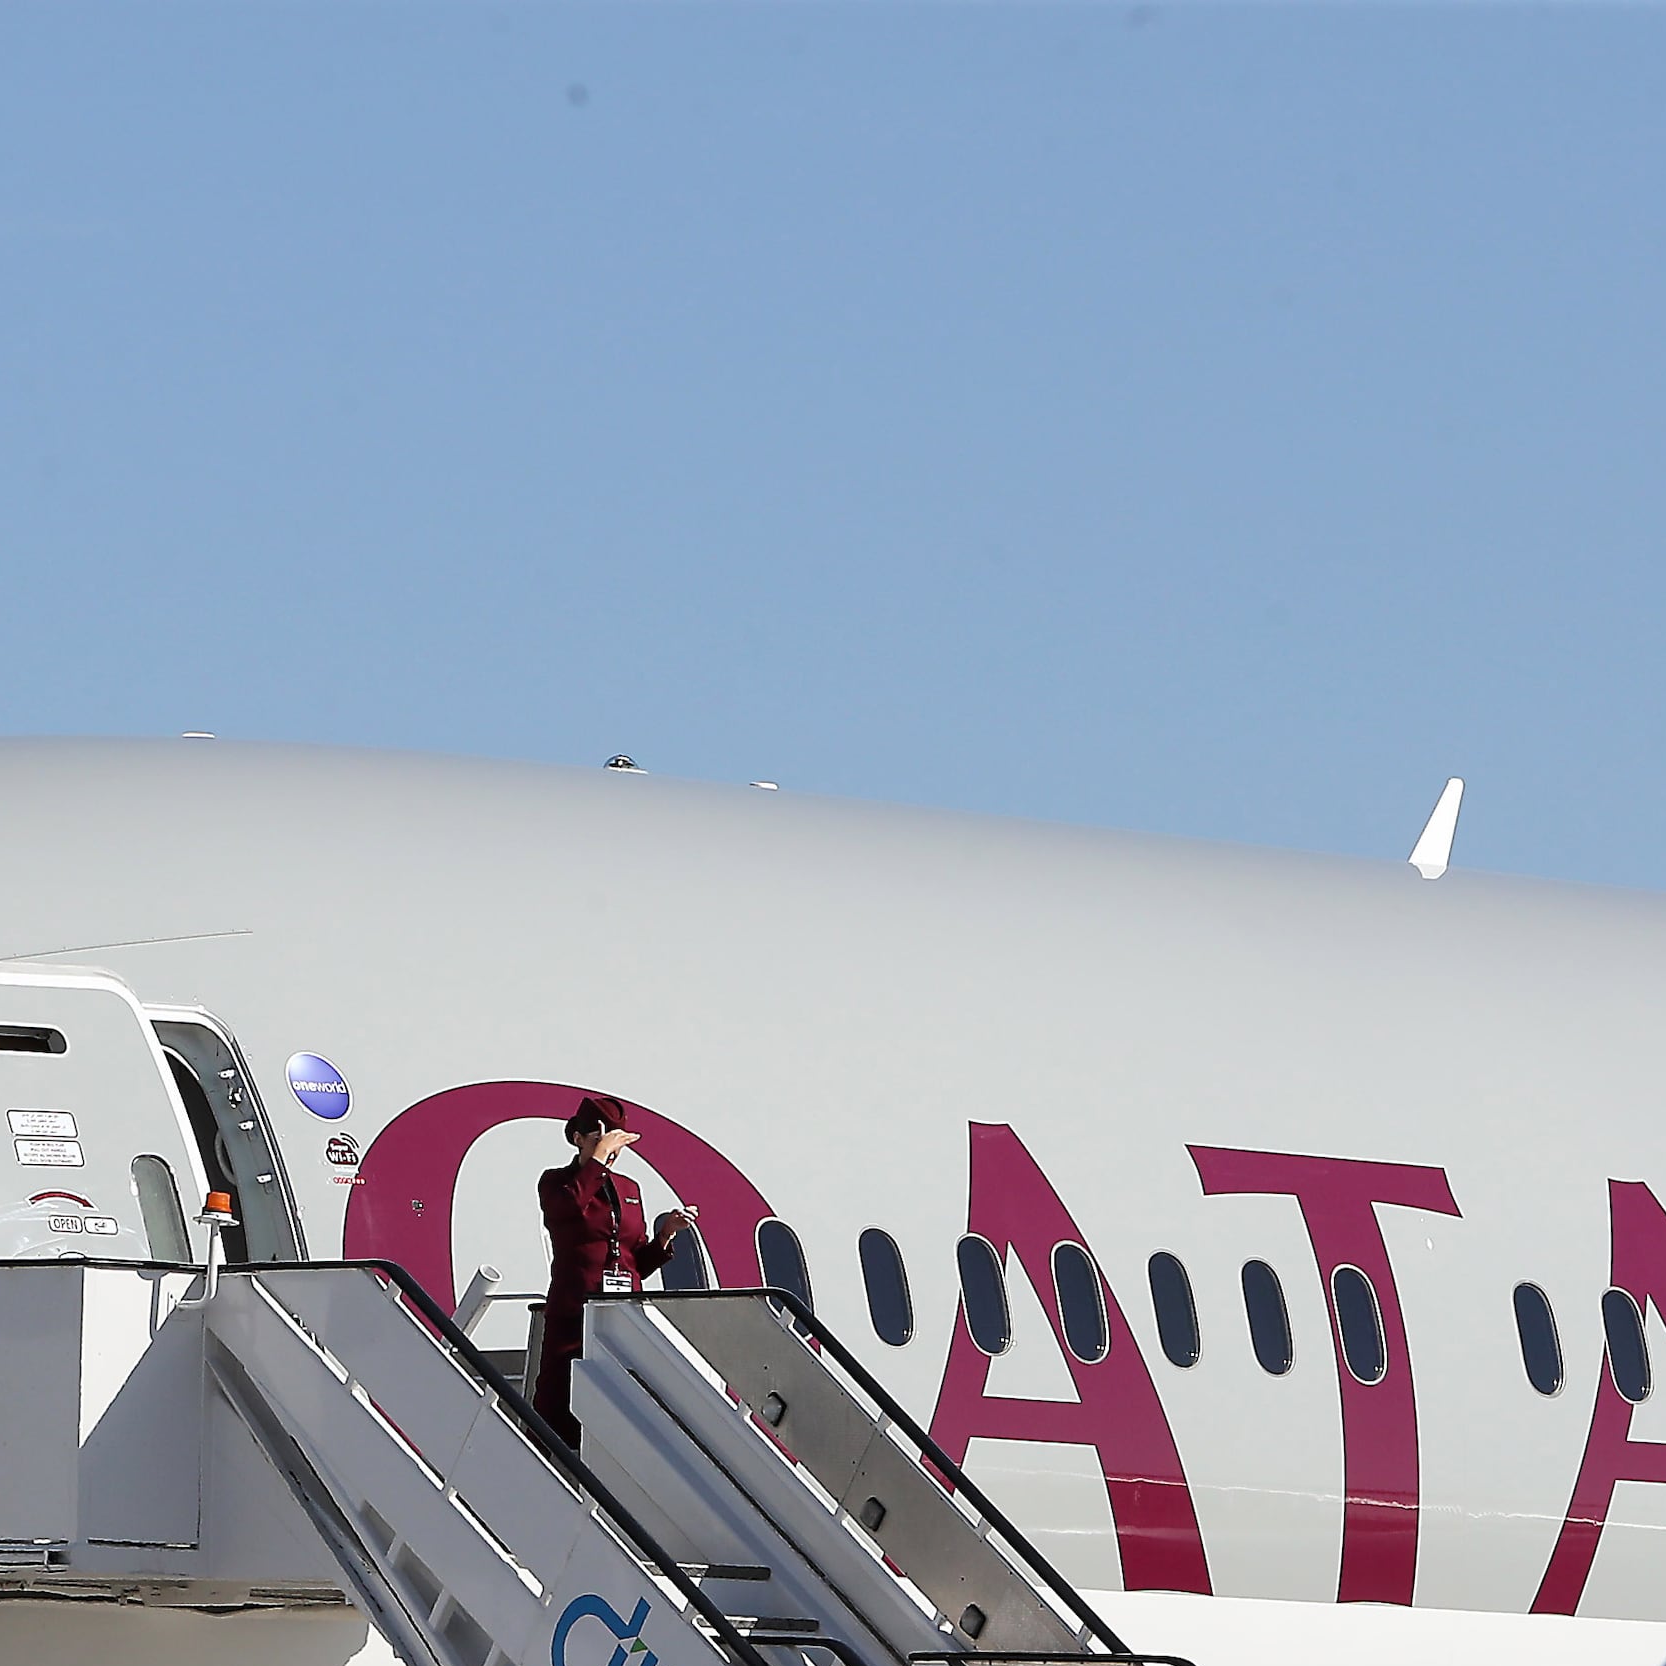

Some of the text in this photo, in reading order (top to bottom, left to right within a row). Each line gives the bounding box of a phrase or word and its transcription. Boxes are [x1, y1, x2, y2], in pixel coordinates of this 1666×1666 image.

[292, 1079, 348, 1094] oneworld
[328, 1151, 357, 1163] Wi-Fi
[53, 1218, 78, 1230] OPEN
